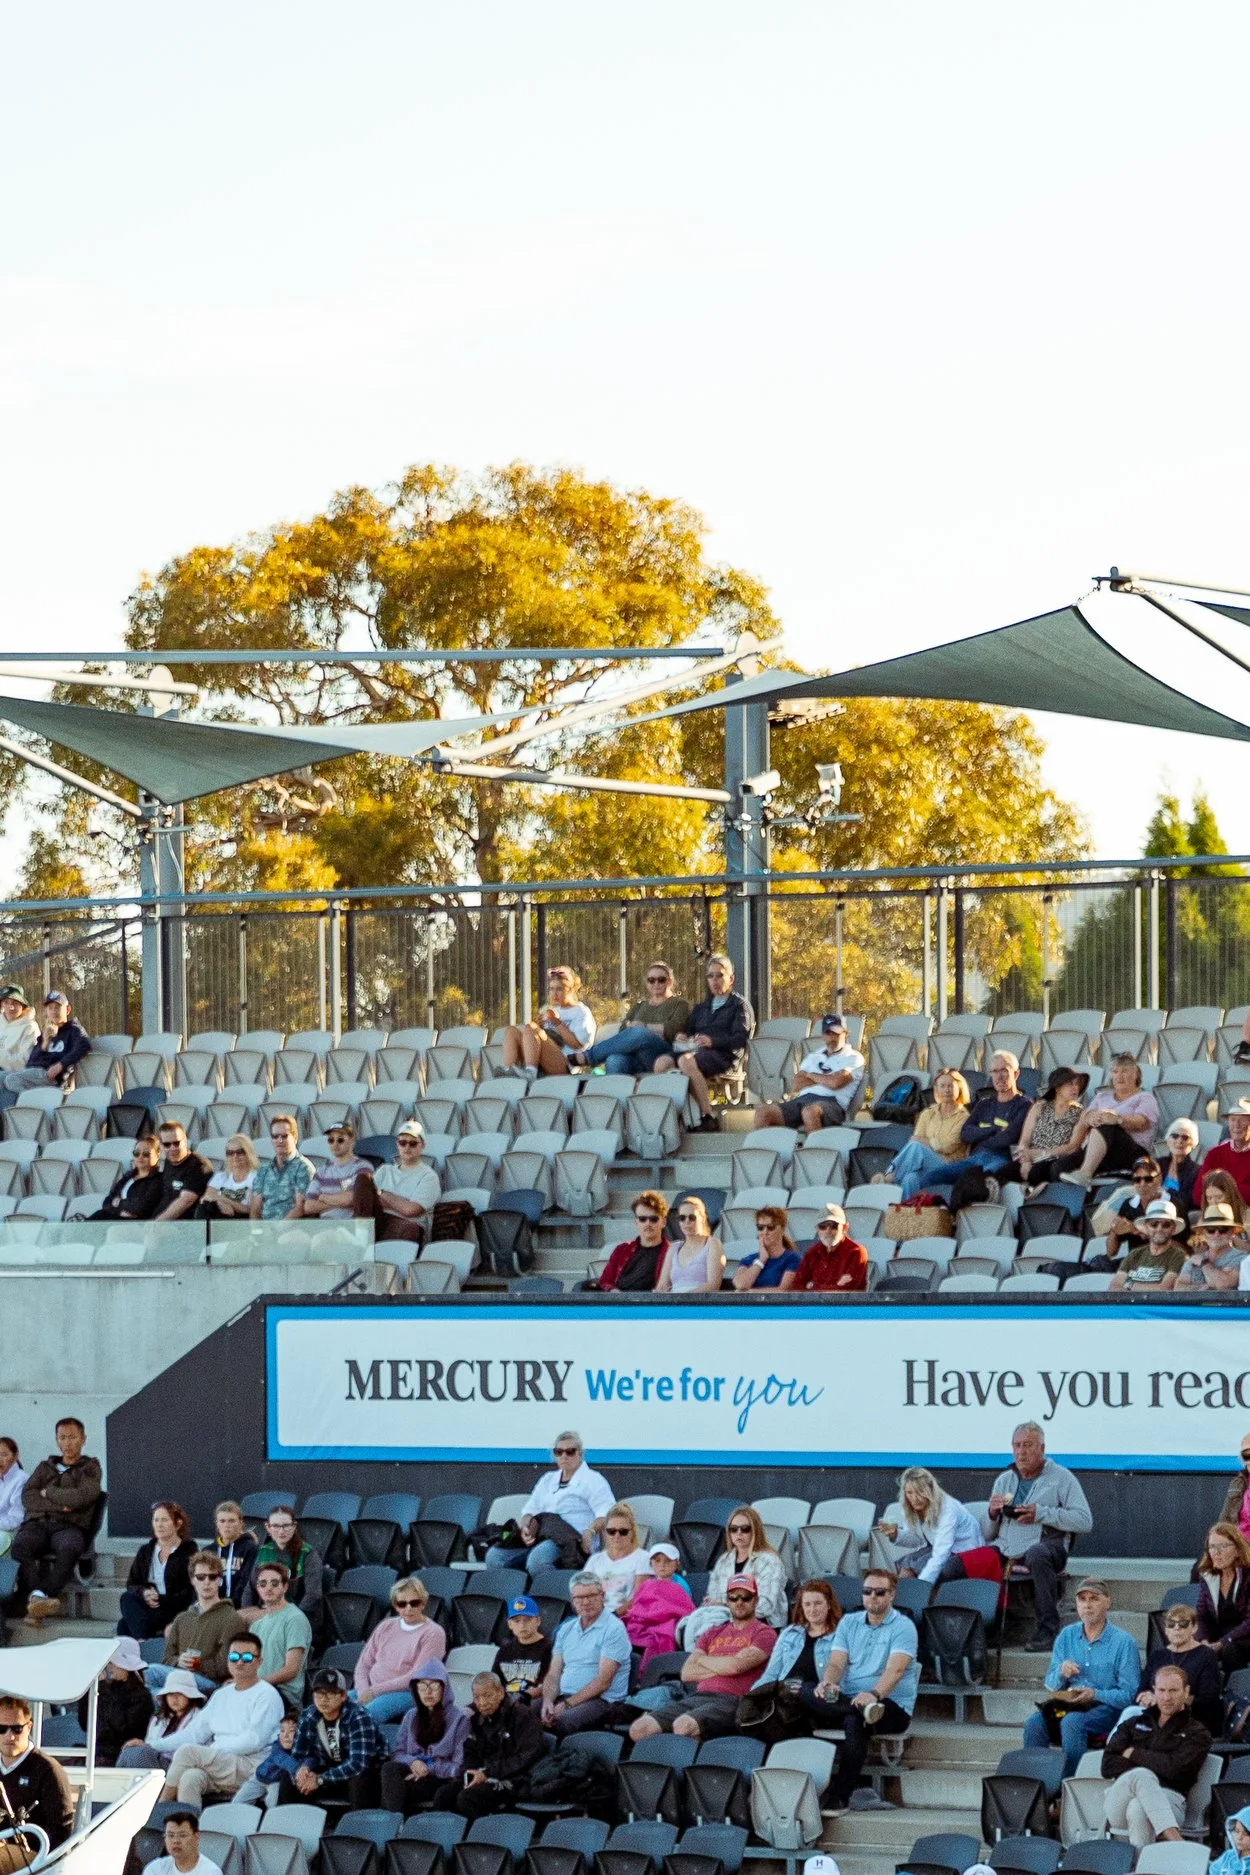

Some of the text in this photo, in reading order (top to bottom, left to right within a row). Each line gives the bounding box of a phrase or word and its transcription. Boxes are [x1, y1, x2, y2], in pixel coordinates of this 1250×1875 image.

[344, 1359, 825, 1437] MERCURY We're for you
[902, 1358, 1025, 1408] Have
[1037, 1370, 1134, 1422] you
